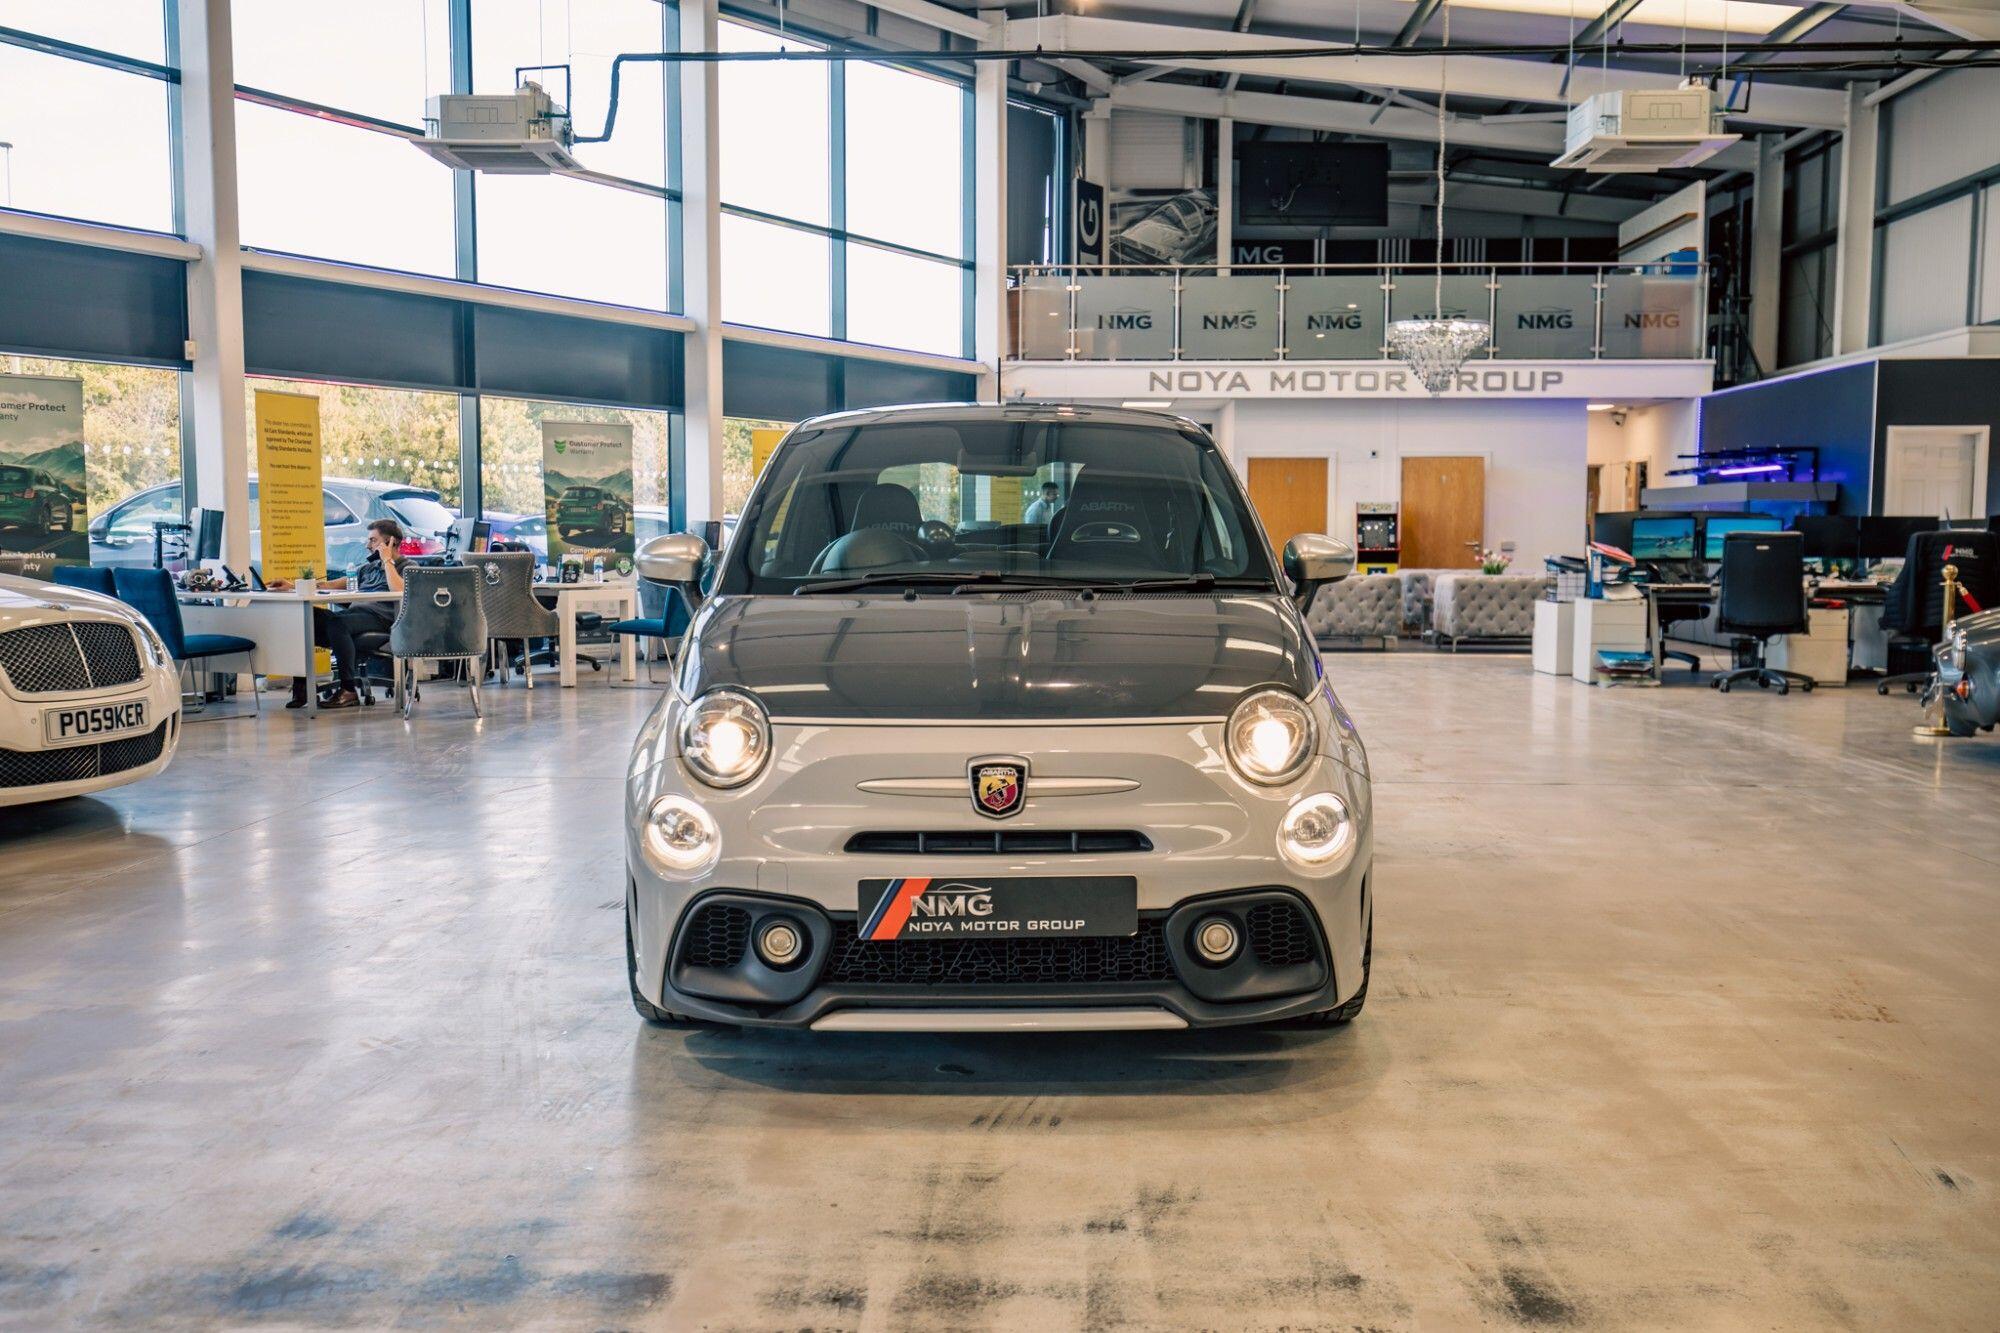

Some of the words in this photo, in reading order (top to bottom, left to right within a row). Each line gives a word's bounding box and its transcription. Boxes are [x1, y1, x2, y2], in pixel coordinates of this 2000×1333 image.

[1232, 246, 1284, 264] MG
[1203, 314, 1257, 330] NMG
[1308, 314, 1362, 330] NMG
[1518, 314, 1573, 329] NMG
[1624, 313, 1680, 329] NMG
[1149, 370, 1251, 392] NOYA
[1270, 370, 1408, 392] MOTOR
[1443, 370, 1564, 392] ROUP
[28, 402, 67, 412] Protect
[910, 895, 994, 917] NMG
[909, 922, 953, 932] NOYA
[961, 921, 1020, 931] MOTOR
[1027, 920, 1086, 931] GROUP
